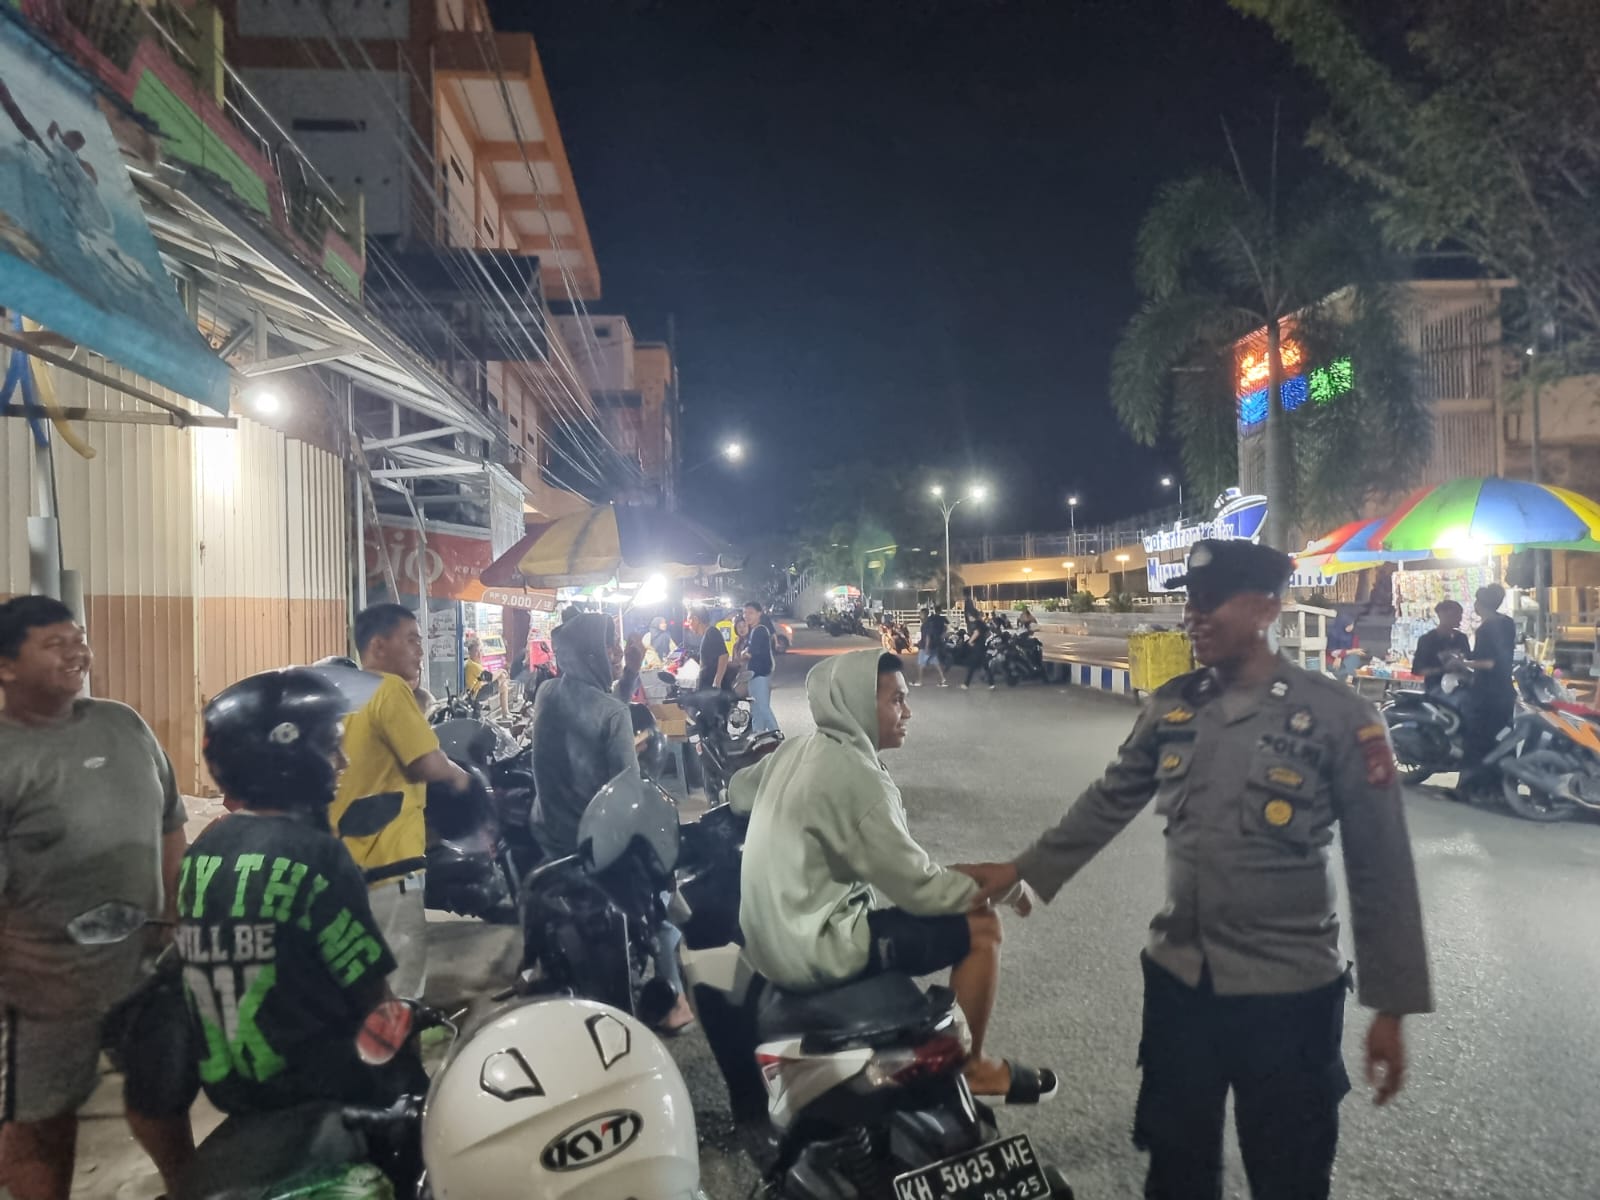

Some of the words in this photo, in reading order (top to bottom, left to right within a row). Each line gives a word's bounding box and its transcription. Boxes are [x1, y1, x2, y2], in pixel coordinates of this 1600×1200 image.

[501, 593, 532, 608] 9.000
[233, 923, 277, 961] BE
[544, 1113, 630, 1169] KYT
[900, 1175, 934, 1200] KH
[940, 1152, 996, 1193] 5835
[1000, 1138, 1033, 1171] ME
